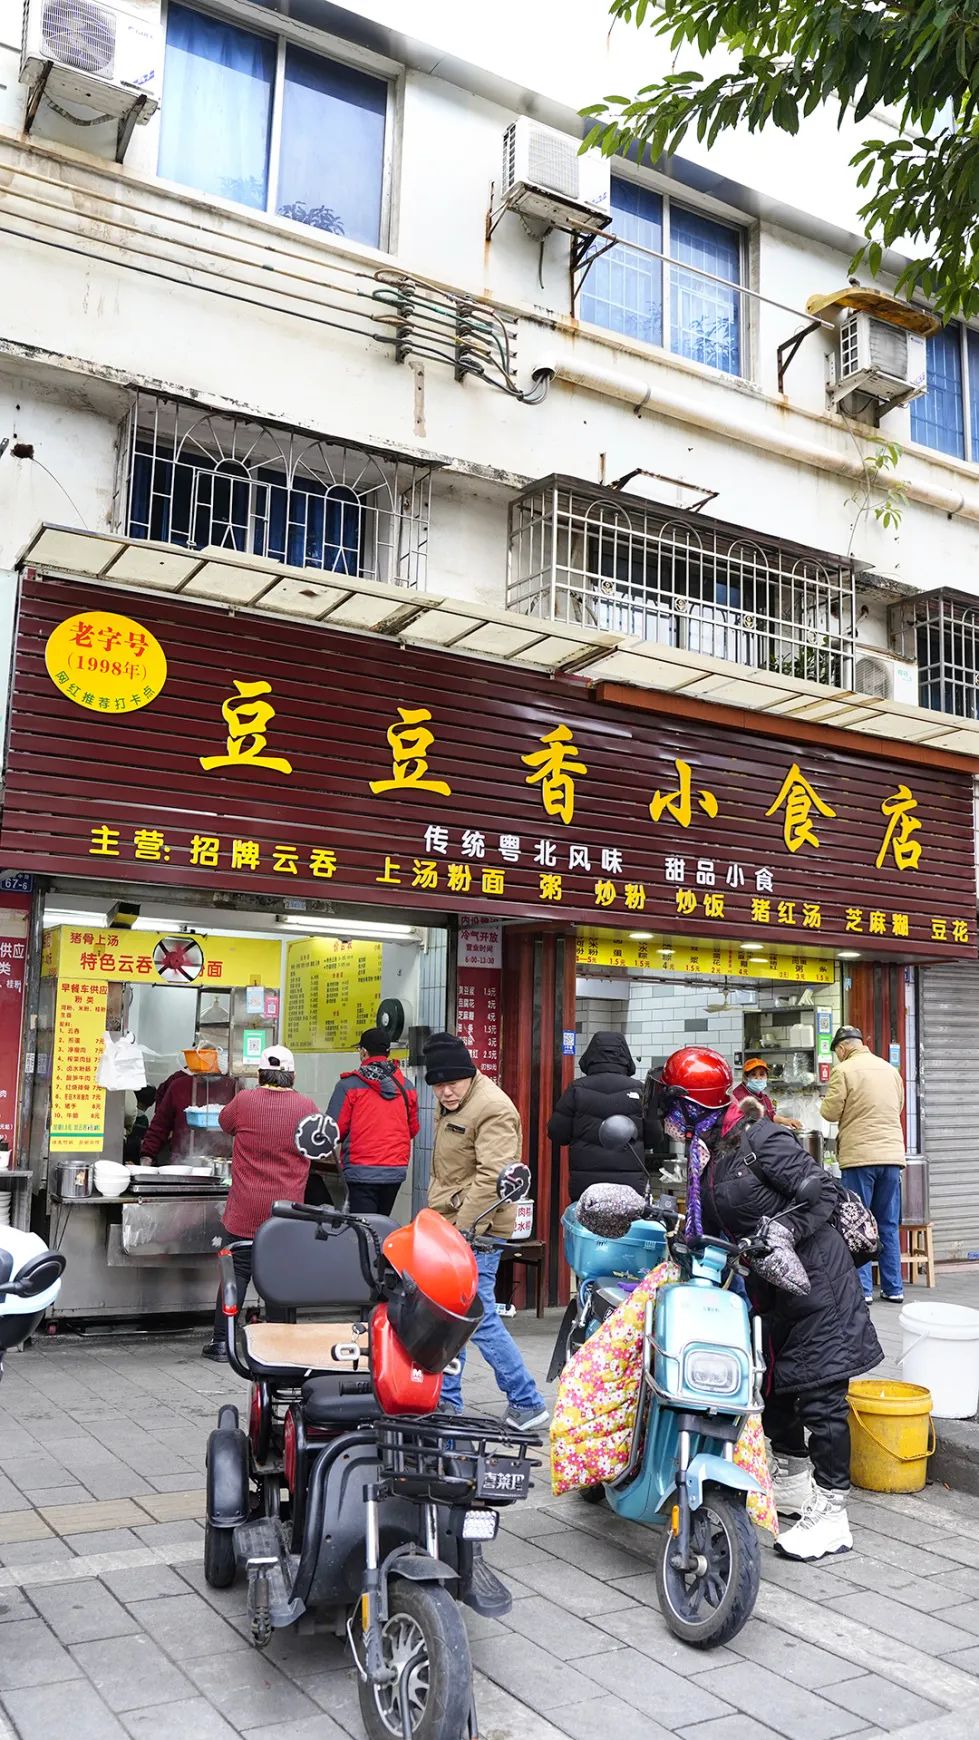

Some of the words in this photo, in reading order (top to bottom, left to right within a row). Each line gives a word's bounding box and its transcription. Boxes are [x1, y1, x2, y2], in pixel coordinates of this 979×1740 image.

[68, 621, 149, 657] 老字号
[56, 671, 156, 711] 网红推荐打卡点
[199, 680, 923, 871] 豆豆香小食店
[424, 825, 623, 874] 传统粤北风味
[664, 857, 774, 893] 甜品小食
[189, 834, 338, 879] 招牌云吞
[376, 856, 506, 895] 上汤粉面
[539, 873, 562, 901] 粥
[595, 879, 647, 910] 炒粉
[676, 888, 725, 918] 炒饭
[751, 898, 822, 928] 猪红汤
[845, 908, 910, 937] 芝麻糊
[930, 918, 970, 943] 豆花
[69, 932, 120, 947] 猪骨上汤
[461, 930, 498, 943] 冷气开放
[61, 983, 108, 995] 早餐车供应
